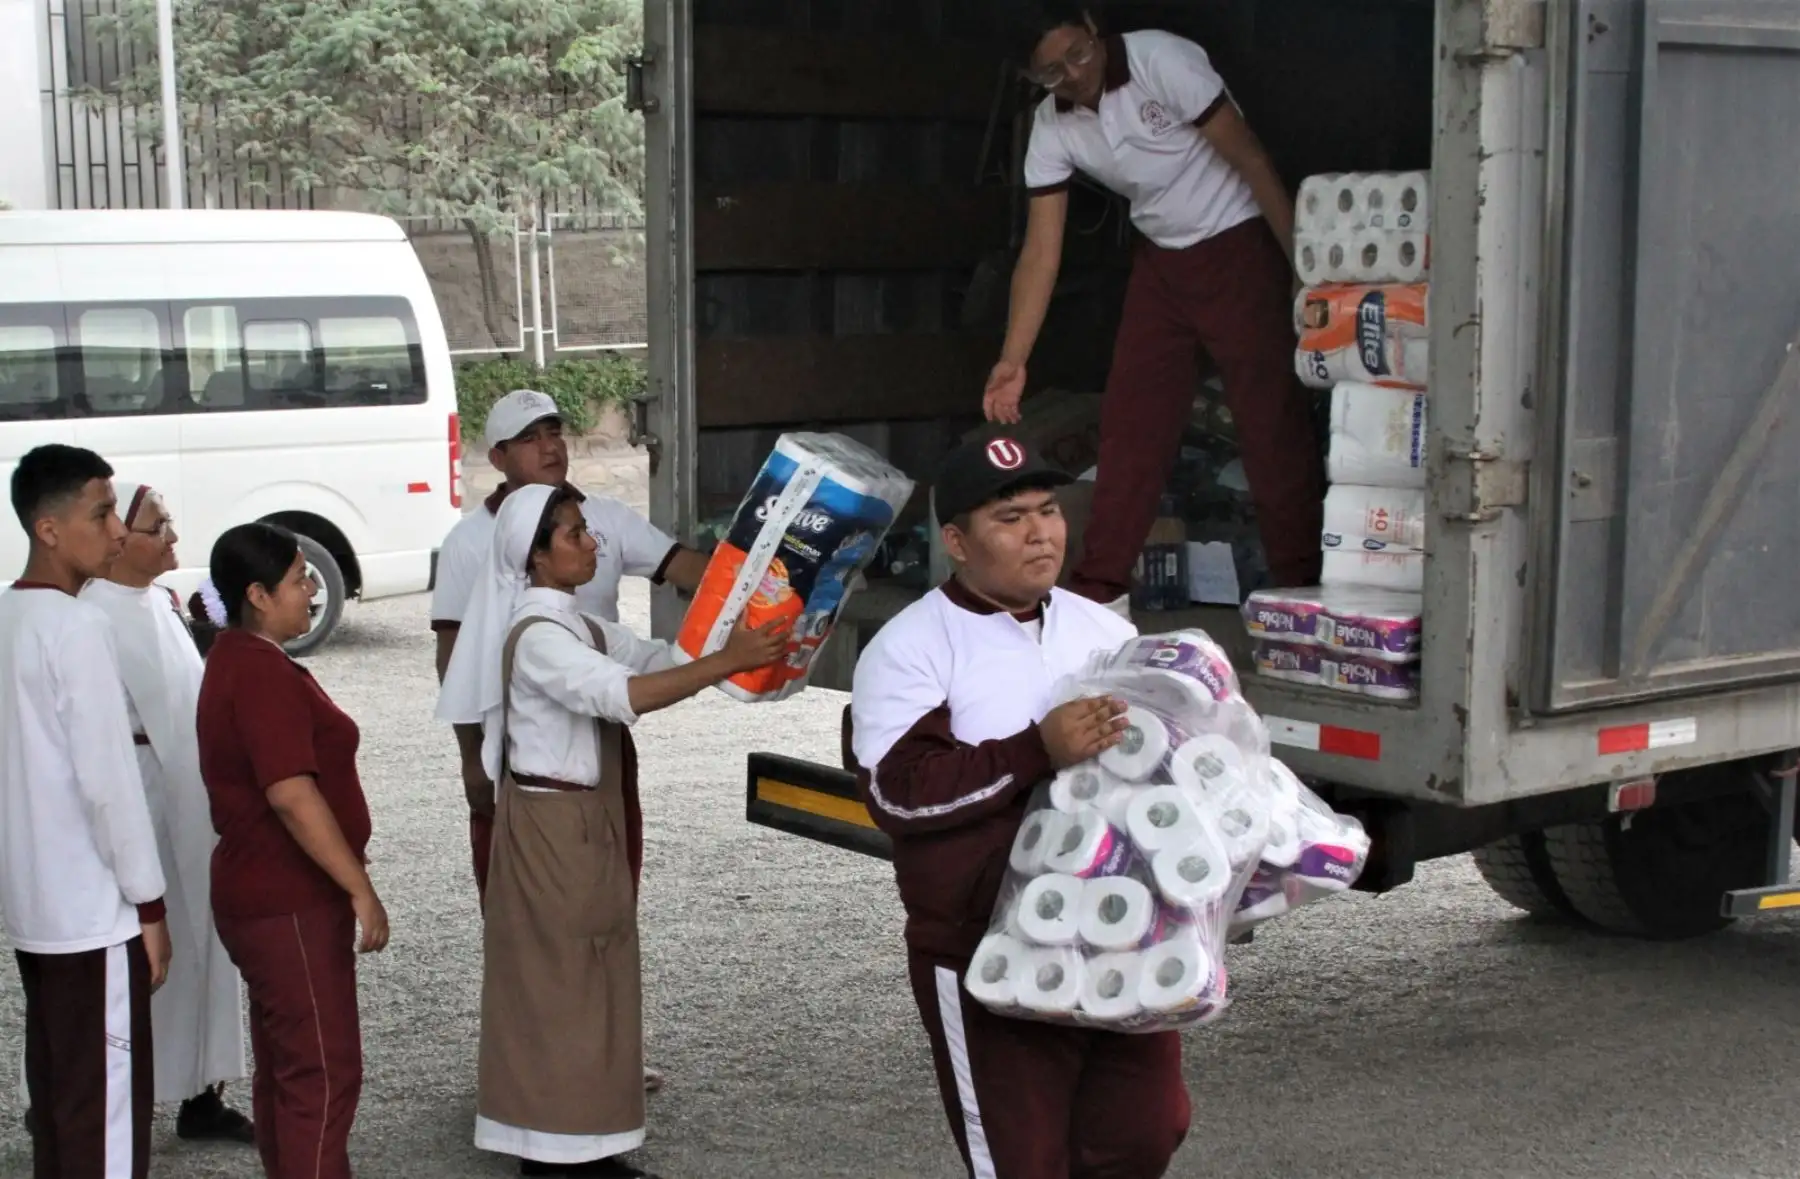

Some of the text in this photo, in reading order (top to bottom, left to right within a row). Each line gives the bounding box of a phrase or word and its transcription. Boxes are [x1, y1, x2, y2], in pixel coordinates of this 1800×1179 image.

[1361, 301, 1381, 369] Elite
[1313, 348, 1330, 381] 40
[988, 439, 1022, 469] U
[1375, 508, 1388, 532] 40
[1257, 610, 1294, 631] Noble
[1336, 624, 1376, 648] Noble
